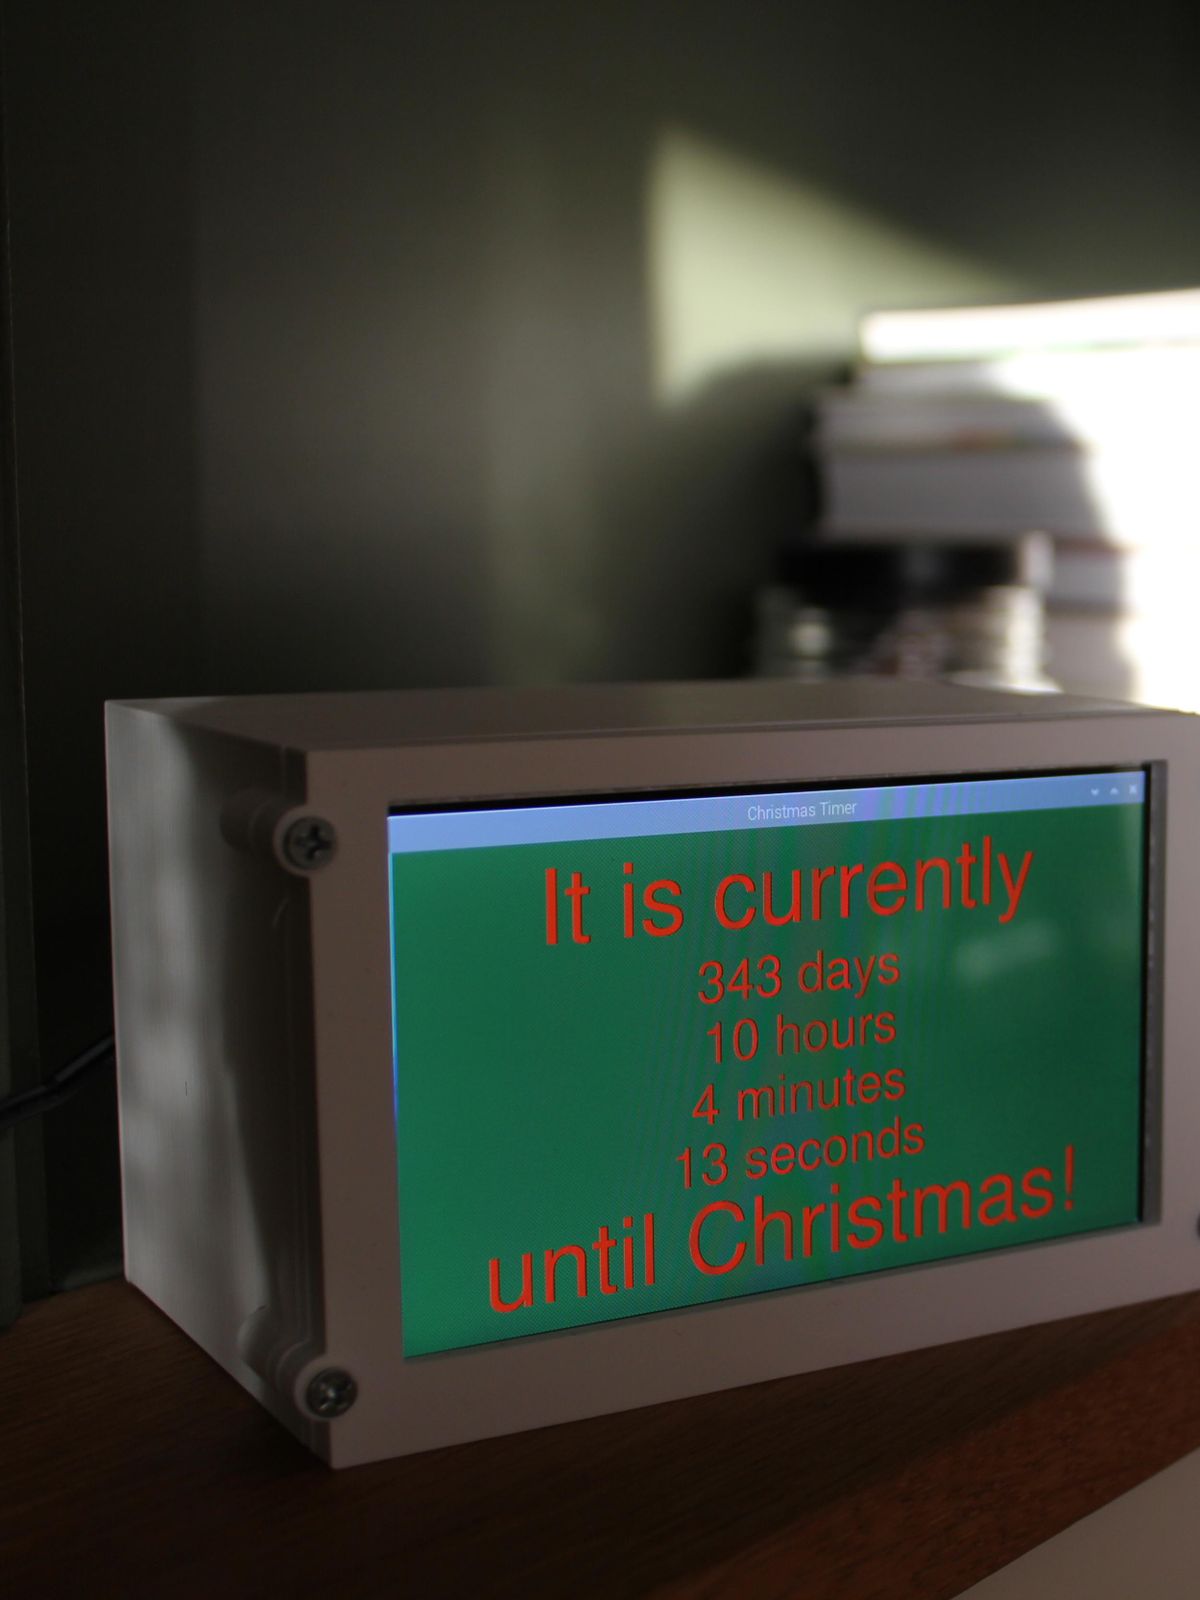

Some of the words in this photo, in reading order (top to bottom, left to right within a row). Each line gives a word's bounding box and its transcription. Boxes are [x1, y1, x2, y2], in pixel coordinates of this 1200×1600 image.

[747, 804, 816, 821] Christmas
[820, 801, 857, 816] Timer
[545, 867, 592, 945] It
[623, 861, 685, 939] is
[714, 835, 1034, 931] currently
[698, 954, 783, 1005] 343
[798, 950, 901, 999] days
[707, 1017, 759, 1064] 10
[776, 1011, 897, 1057] hours
[692, 1083, 720, 1126] 4
[737, 1067, 907, 1121] minutes
[676, 1142, 729, 1189] 13
[745, 1115, 925, 1180] seconds
[489, 1212, 656, 1313] until
[688, 1144, 1075, 1276] Christmas!
